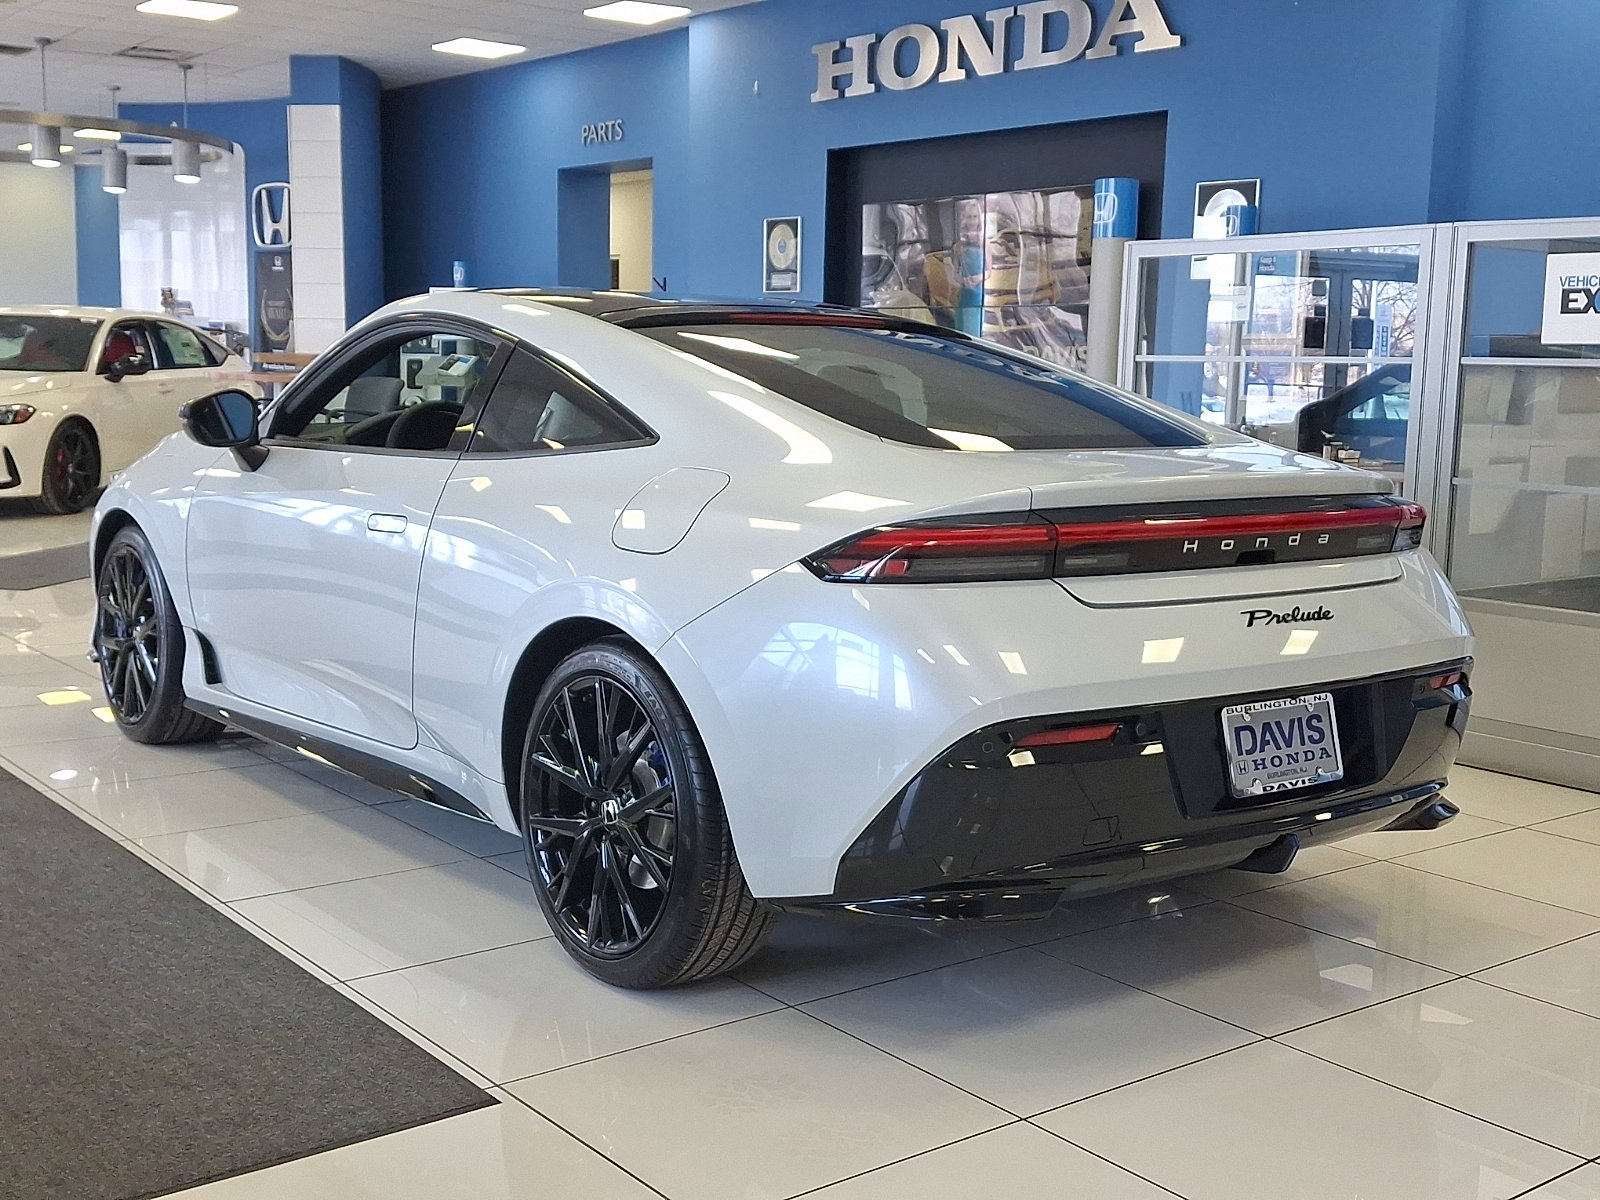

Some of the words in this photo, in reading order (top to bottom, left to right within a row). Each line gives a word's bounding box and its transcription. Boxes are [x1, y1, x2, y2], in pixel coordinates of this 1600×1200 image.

[811, 0, 1181, 103] HONDA
[581, 119, 624, 147] PARTS
[1559, 274, 1600, 288] VEHIC
[1182, 532, 1331, 553] Honda
[1240, 605, 1334, 628] Prelude
[1313, 693, 1329, 702] NJ
[1233, 713, 1326, 757] DAVIS
[1251, 747, 1333, 772] HONDA
[1262, 776, 1318, 792] DAVIS
